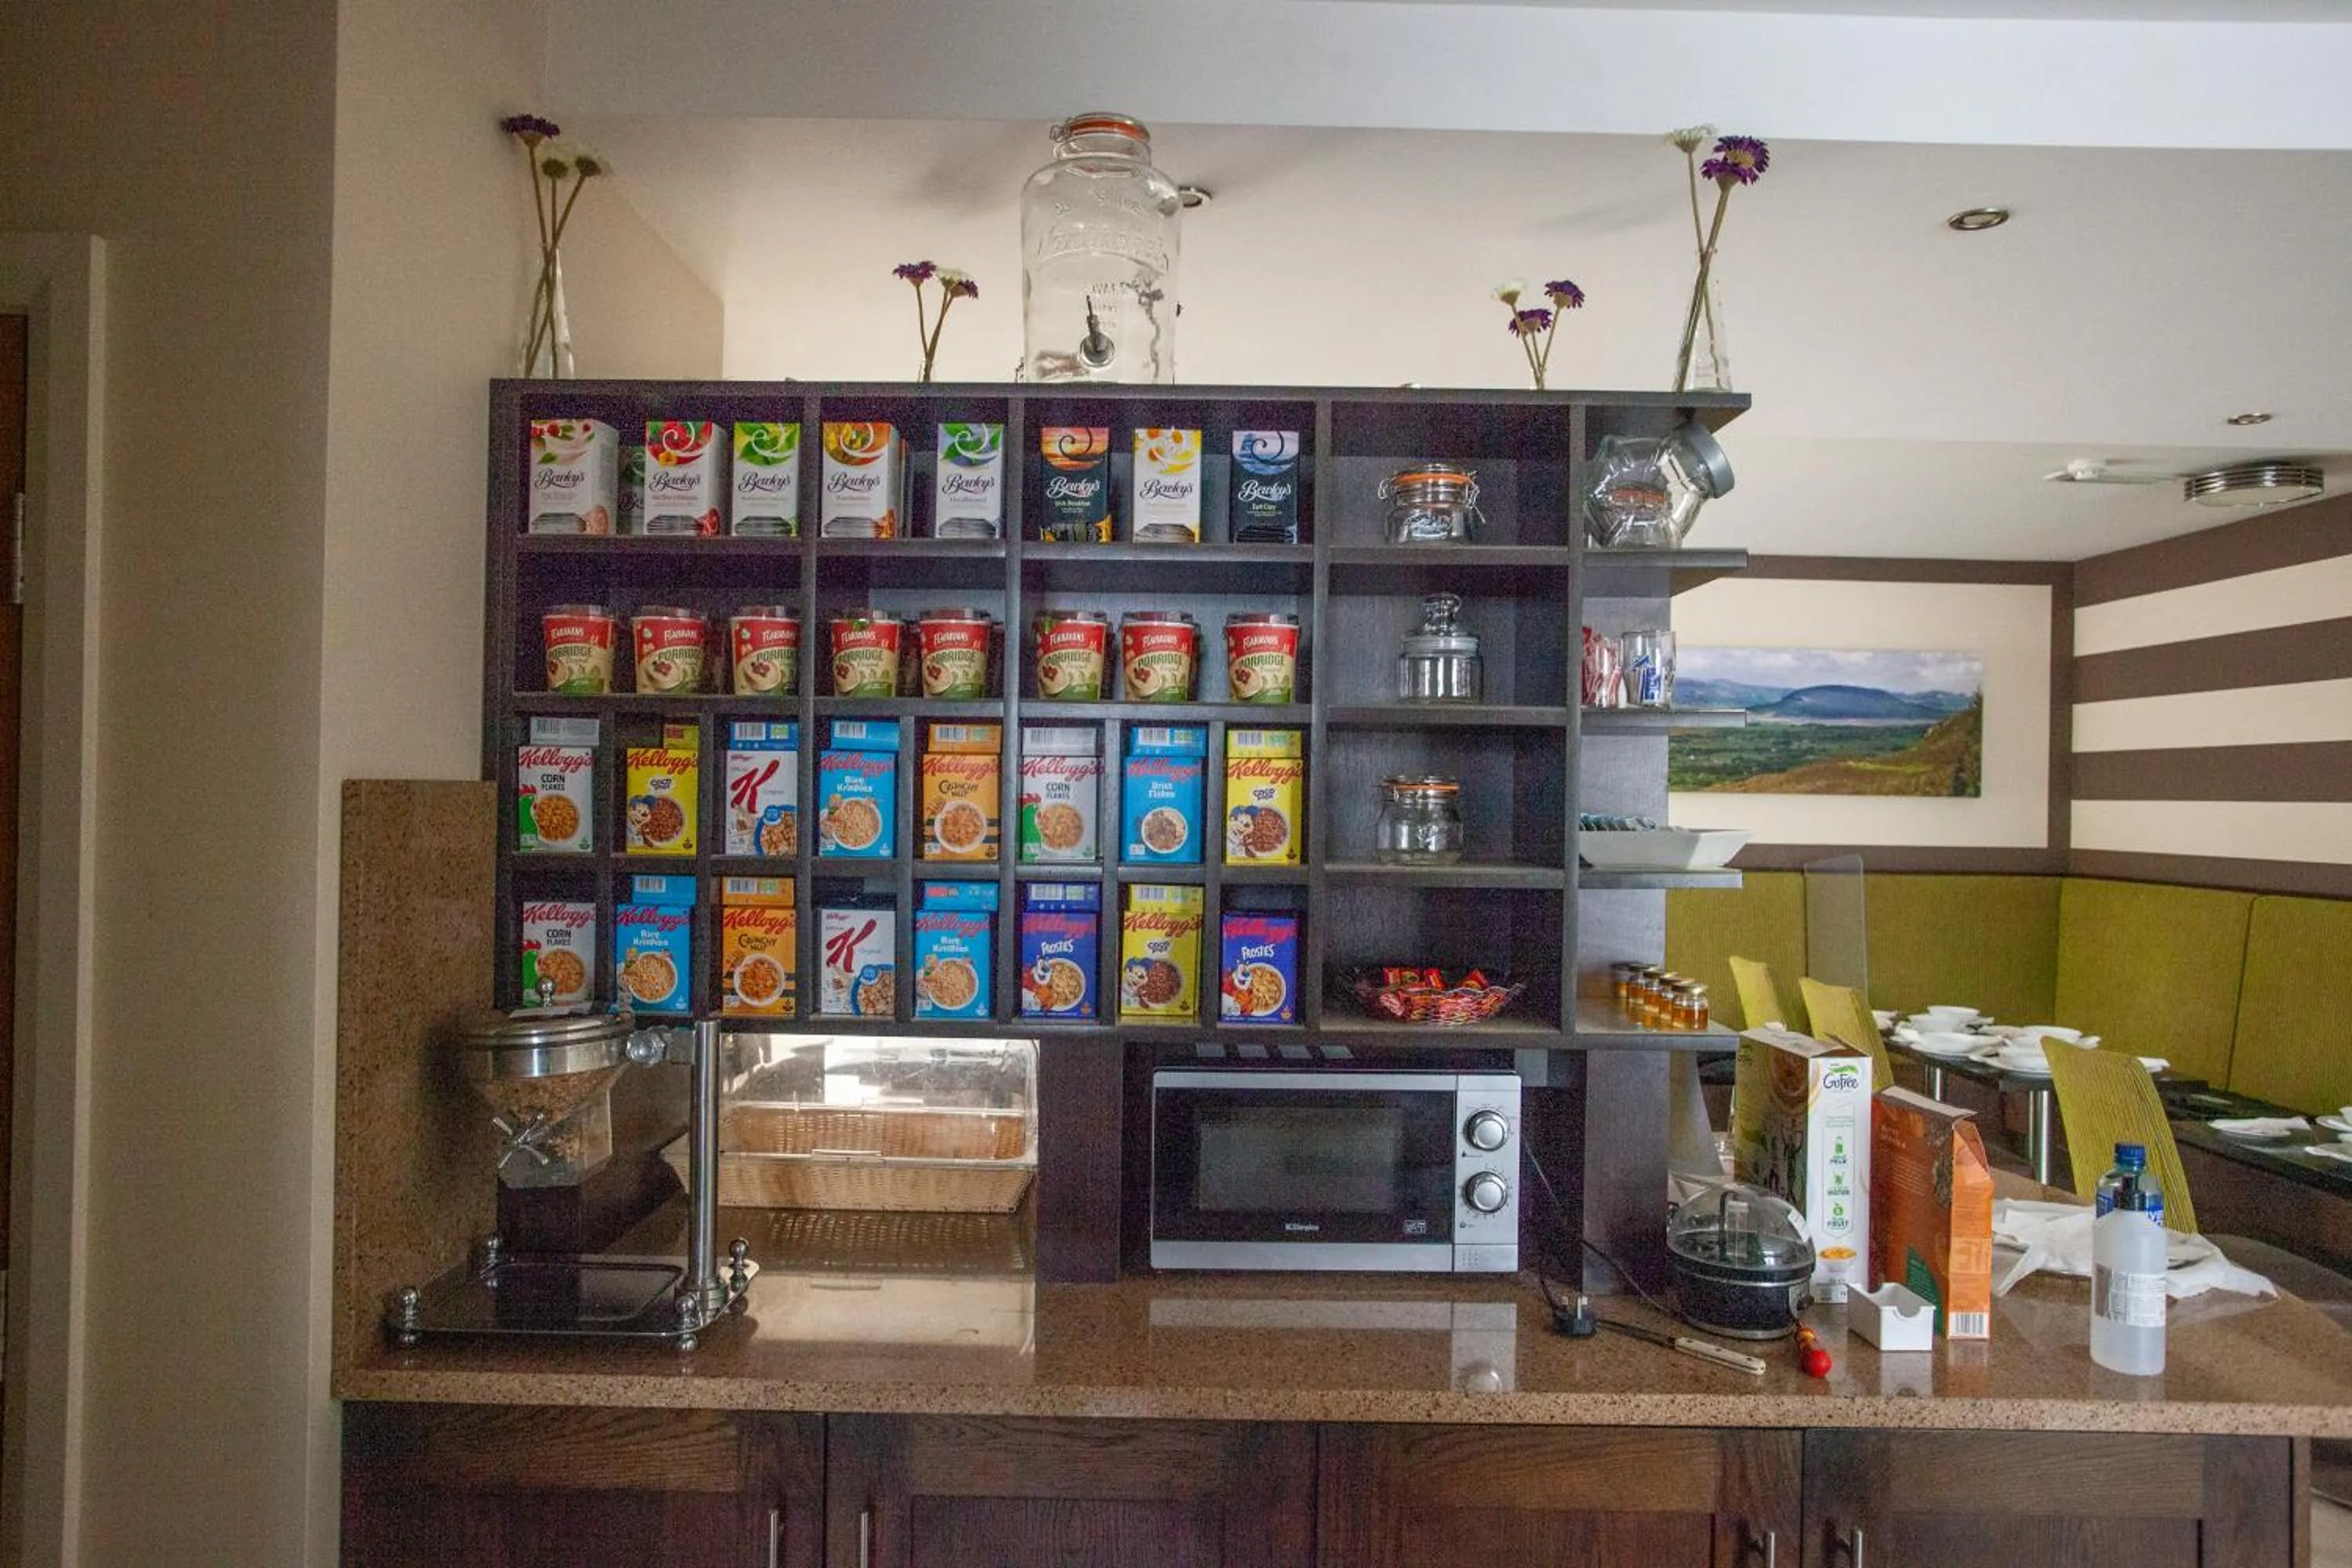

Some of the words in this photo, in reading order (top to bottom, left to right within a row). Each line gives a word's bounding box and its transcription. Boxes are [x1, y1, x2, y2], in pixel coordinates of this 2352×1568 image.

[1046, 476, 1100, 499] Bewley's
[1139, 478, 1193, 500] Bewley's
[1238, 479, 1292, 502] Bewley's
[519, 748, 596, 772] Kellogg's
[924, 755, 1001, 780] Kellogg's
[1020, 754, 1105, 781] Kellogg's
[541, 774, 565, 782] CORN
[731, 758, 780, 814] K
[1045, 782, 1070, 792] CORN
[724, 908, 797, 935] Kellogg's
[546, 929, 572, 938] CORN
[826, 918, 877, 973] K
